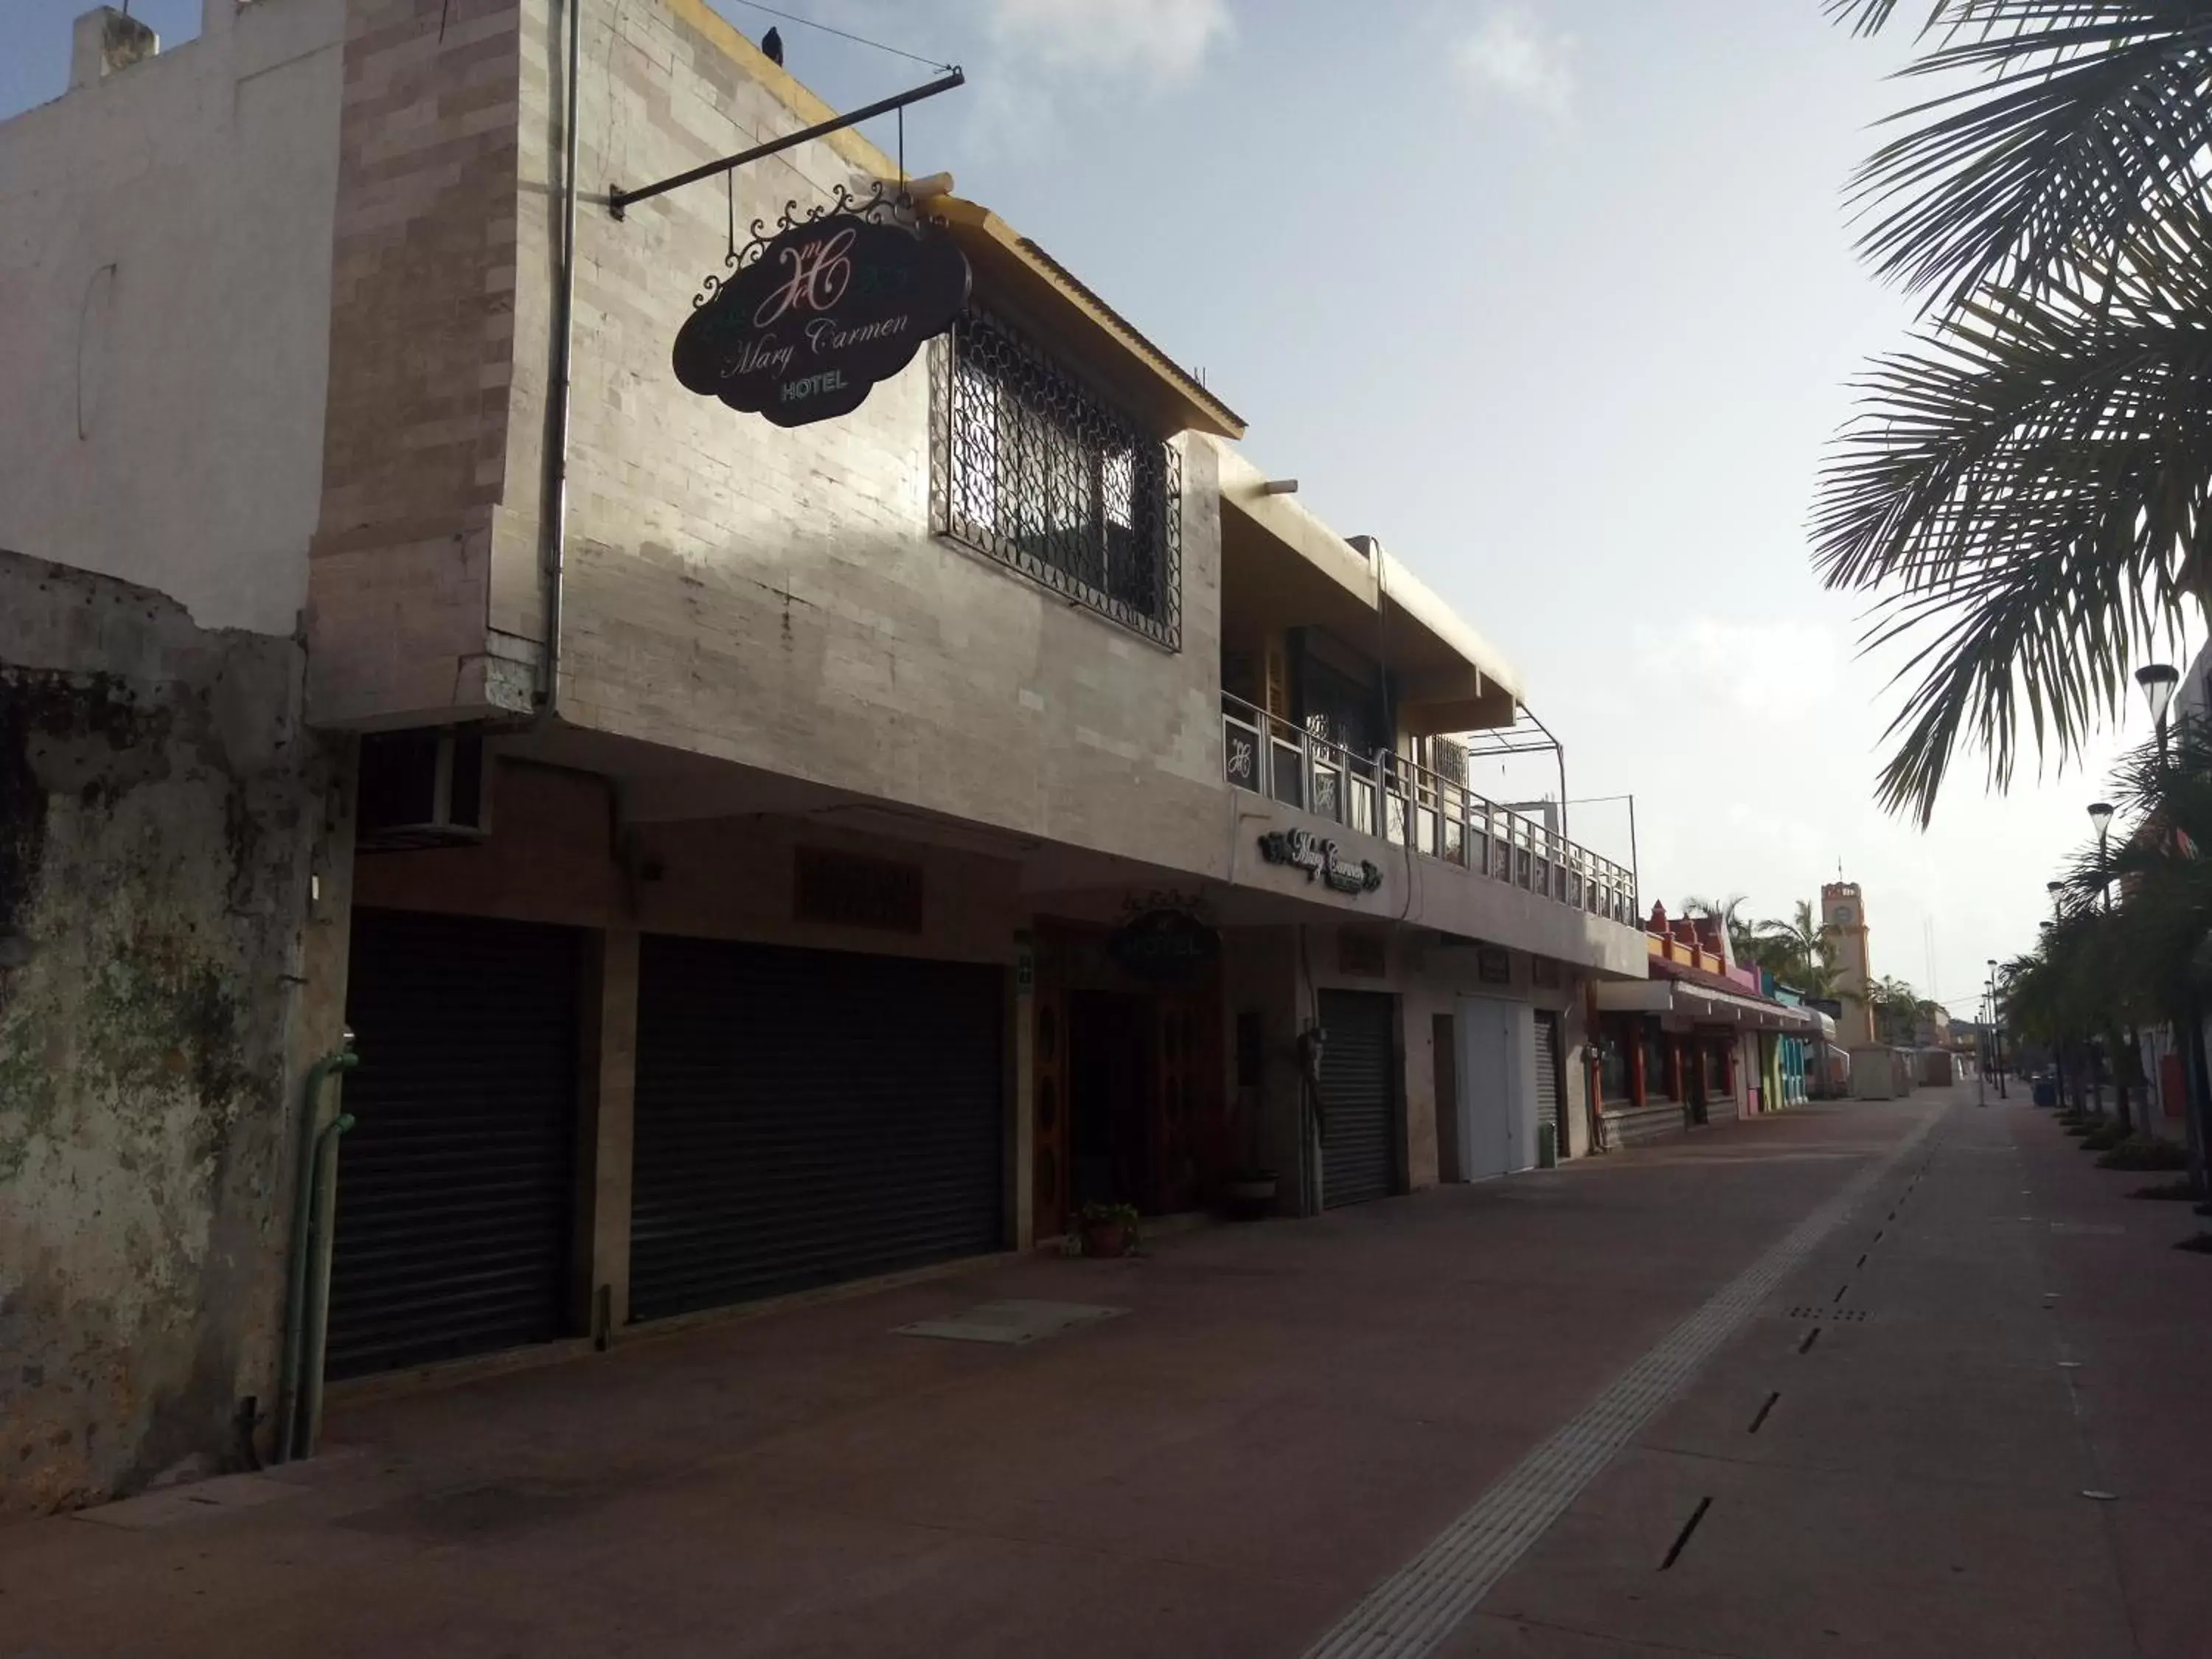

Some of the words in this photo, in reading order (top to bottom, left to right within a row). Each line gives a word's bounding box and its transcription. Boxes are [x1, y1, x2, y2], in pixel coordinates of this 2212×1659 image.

[720, 333, 794, 380] Mary
[805, 317, 908, 354] Carmen
[782, 369, 849, 401] HOTEL
